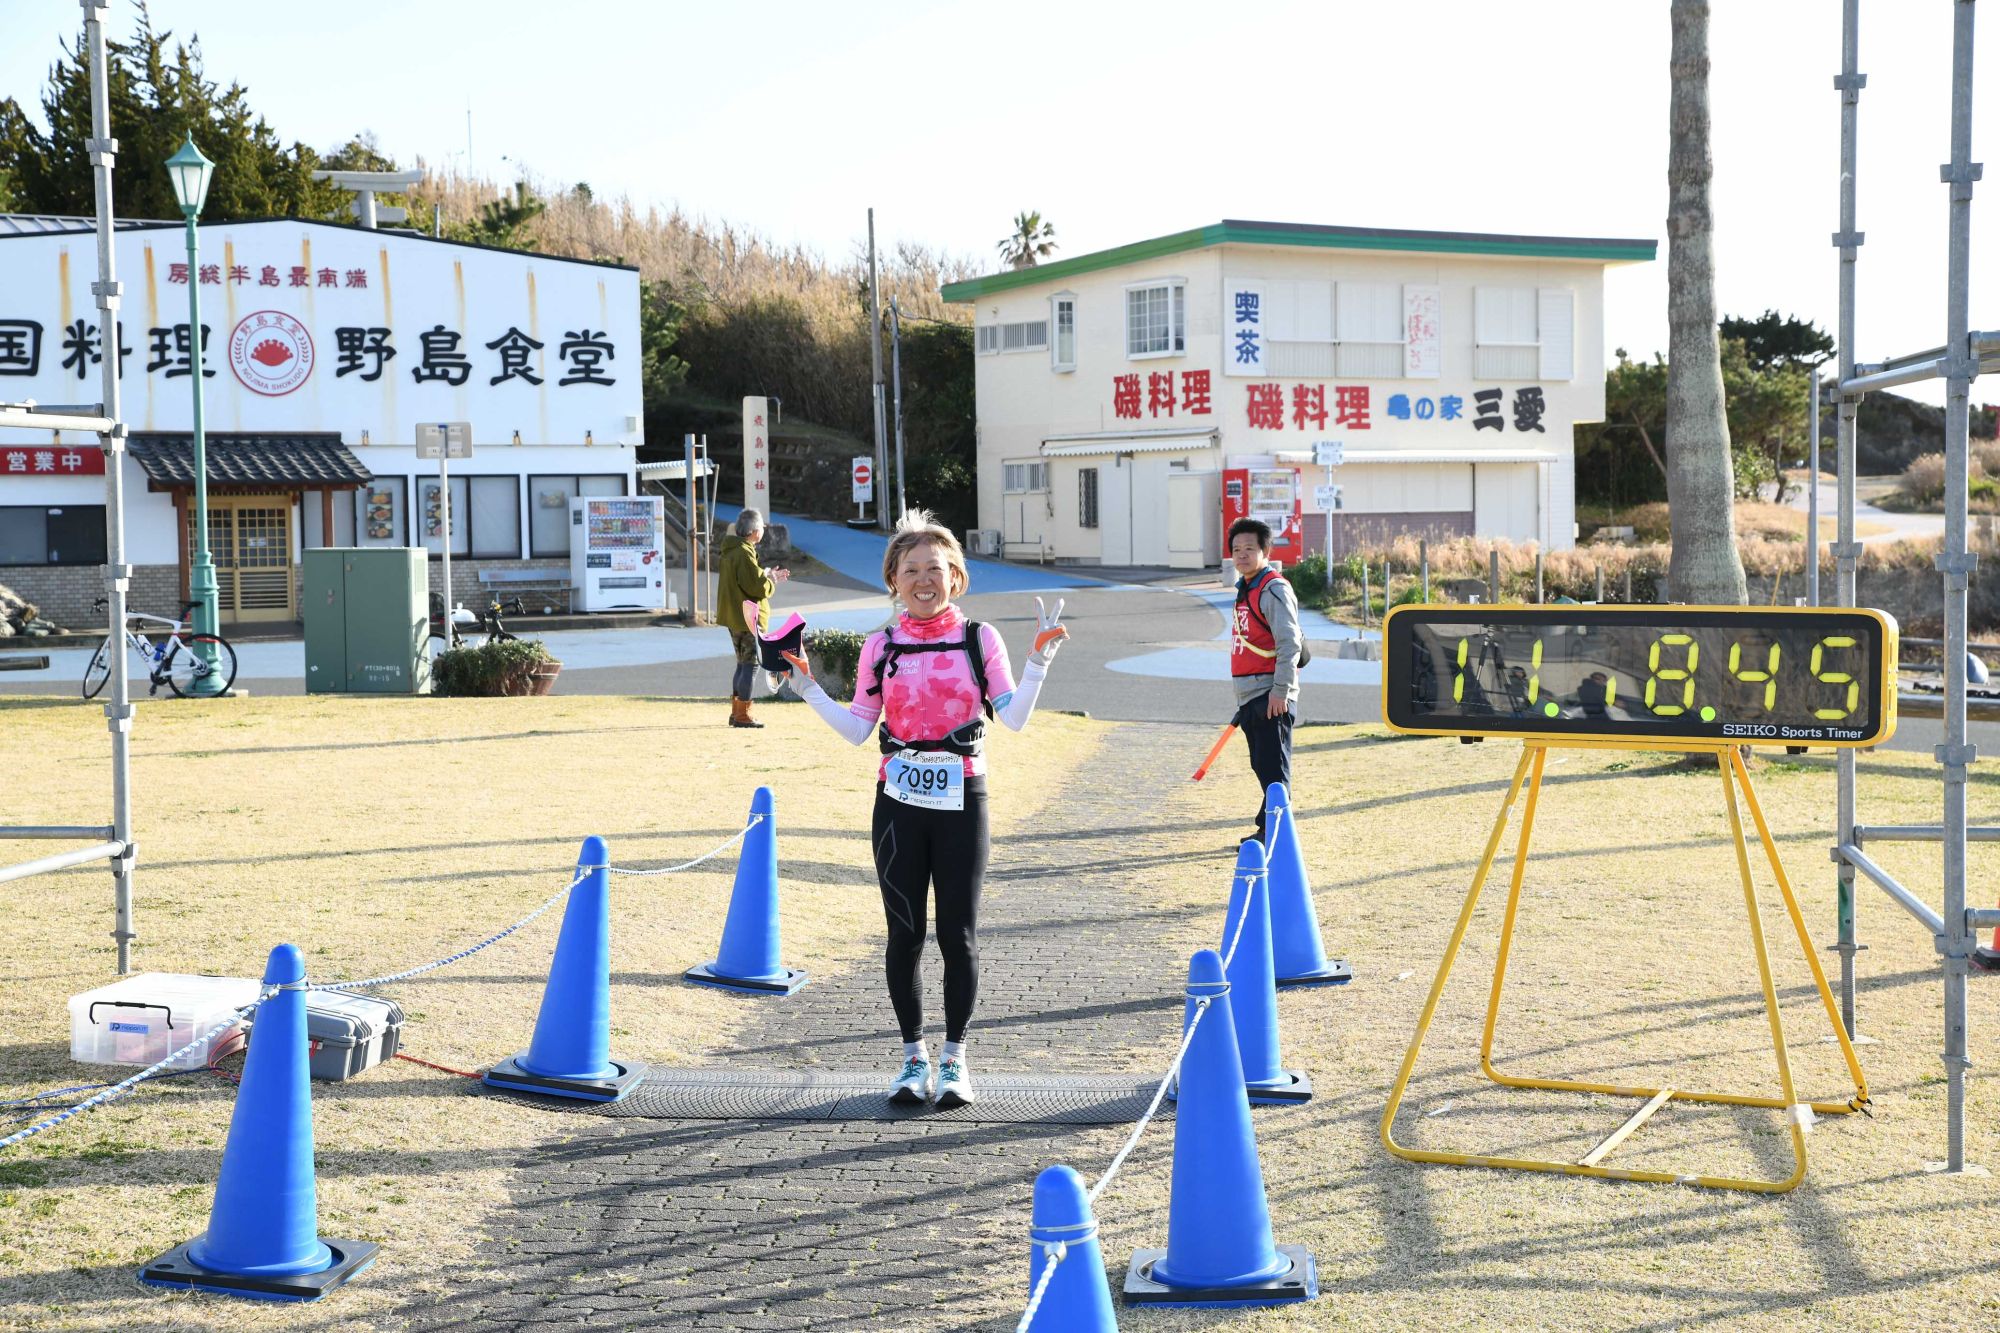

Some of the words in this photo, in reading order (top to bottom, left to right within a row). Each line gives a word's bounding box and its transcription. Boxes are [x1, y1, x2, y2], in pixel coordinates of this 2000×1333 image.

[167, 262, 368, 289] 房総半島最南端
[1234, 290, 1260, 364] 喫茶
[334, 324, 617, 387] 野島食堂
[242, 367, 269, 390] NOJIMA
[271, 366, 304, 390] SHOKUDO
[1113, 369, 1212, 420] 磯料理
[1246, 383, 1372, 431] 磯料理
[1387, 393, 1464, 421] 亀の家
[1472, 386, 1546, 434] 三愛
[6, 451, 82, 472] 営業中
[1722, 723, 1777, 736] SEIKO
[1781, 726, 1822, 738] Sports
[1826, 727, 1862, 738] Timer
[897, 764, 948, 791] 7099
